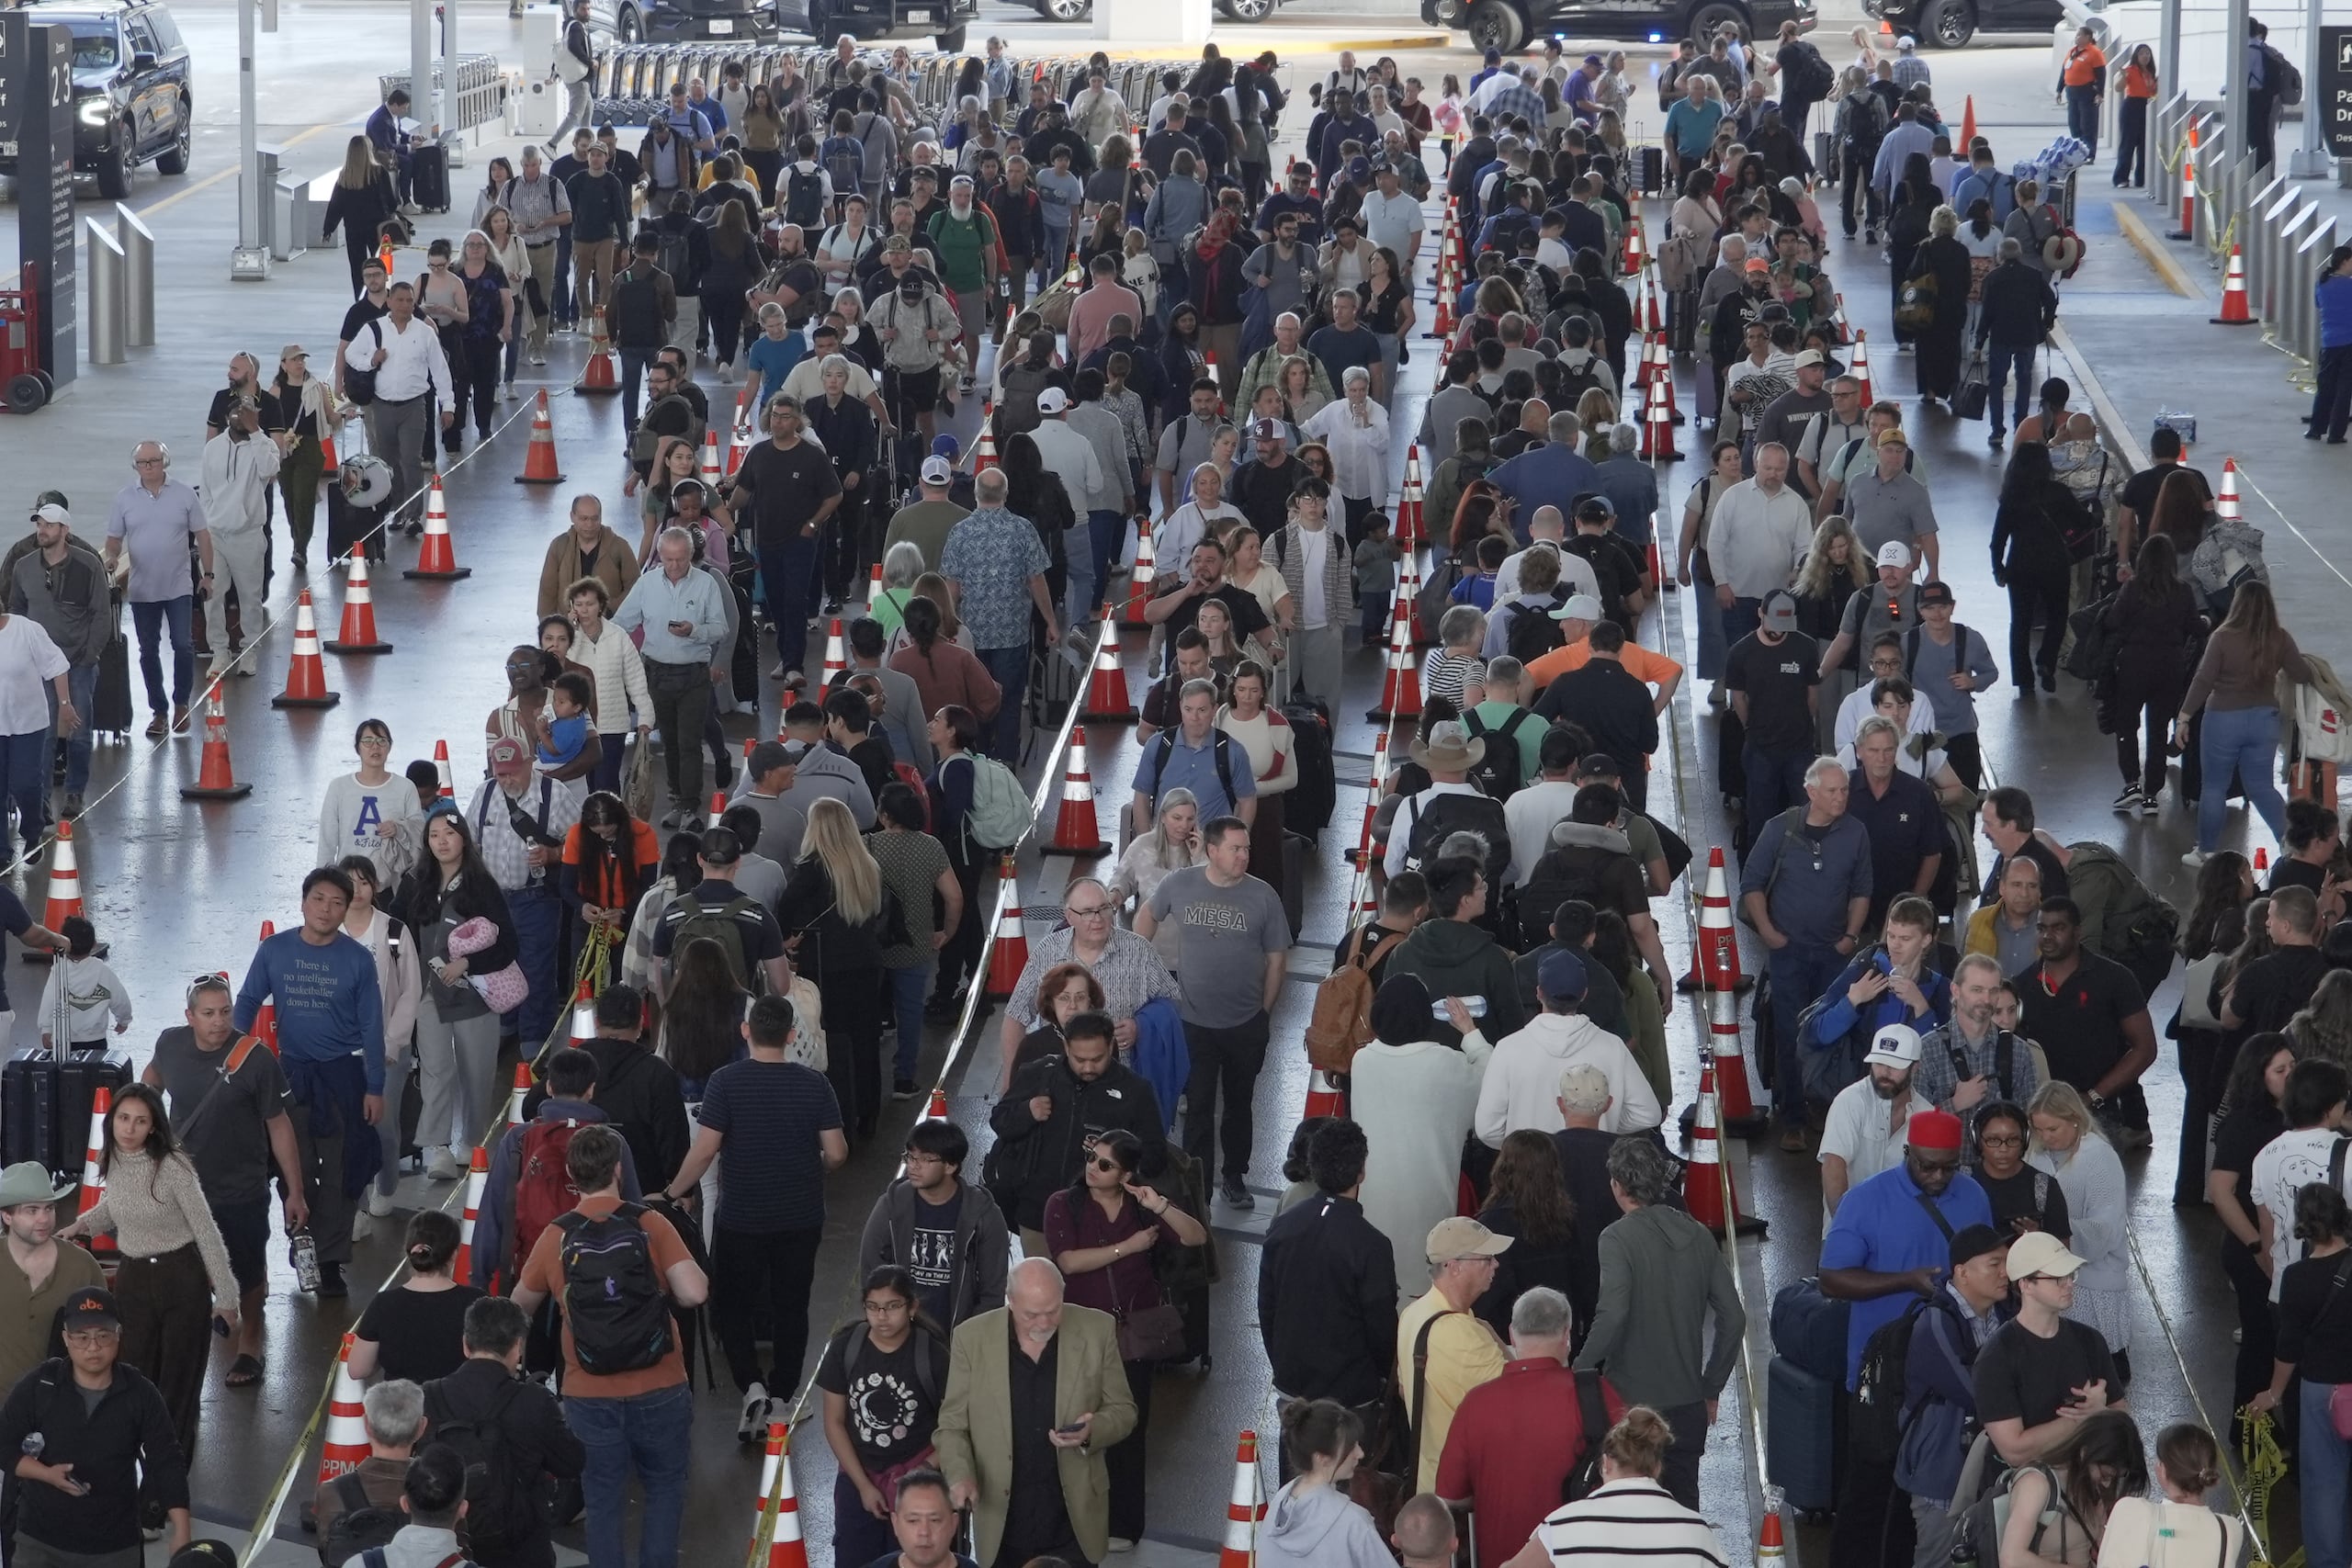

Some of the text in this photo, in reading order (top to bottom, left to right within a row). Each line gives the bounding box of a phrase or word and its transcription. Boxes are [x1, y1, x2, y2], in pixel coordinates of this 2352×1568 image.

[51, 62, 71, 107] 2 3
[353, 796, 381, 836] A
[1183, 906, 1248, 931] MESA
[295, 959, 330, 972] There is
[297, 974, 338, 986] intelligent
[285, 985, 334, 998] basketballer
[287, 998, 309, 1008] down
[79, 1298, 103, 1310] abc
[323, 1459, 356, 1475] PPM
